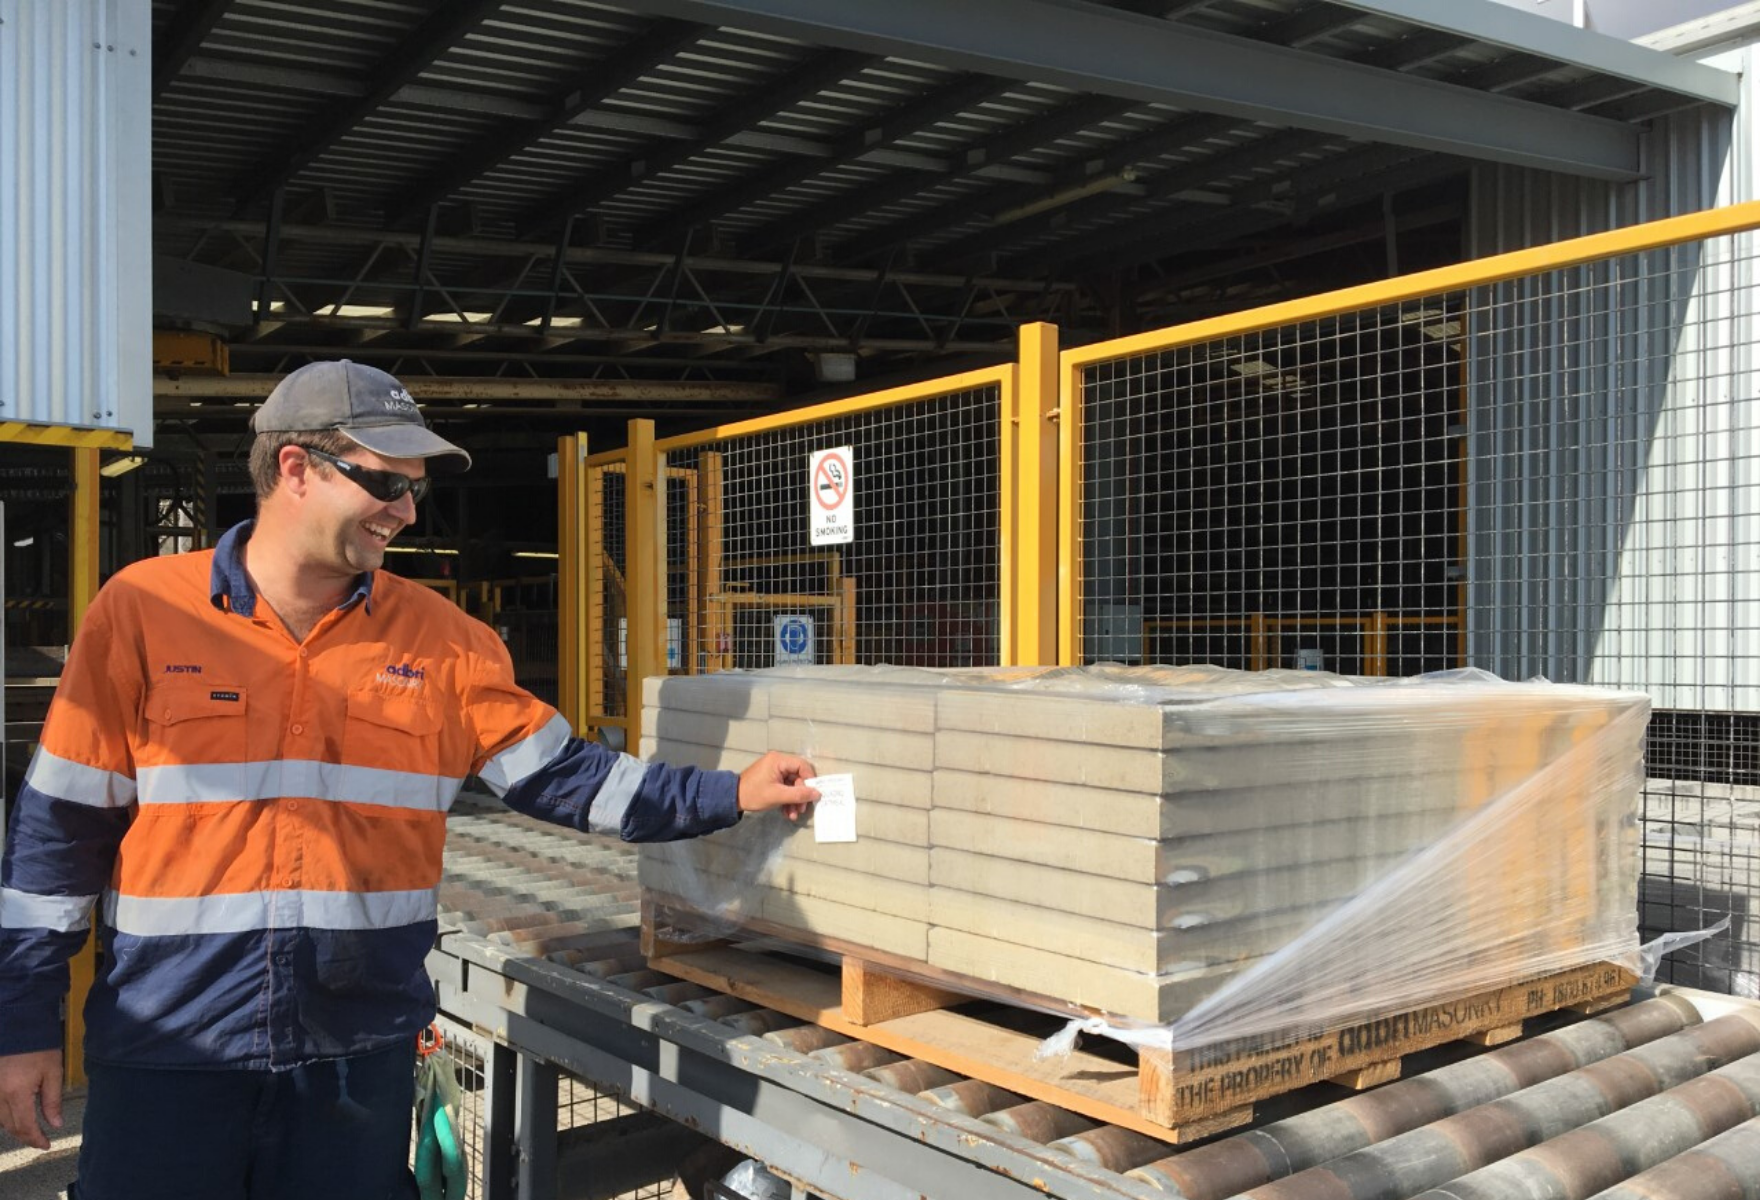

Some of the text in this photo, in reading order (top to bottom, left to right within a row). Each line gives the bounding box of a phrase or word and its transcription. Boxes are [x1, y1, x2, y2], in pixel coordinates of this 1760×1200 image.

[826, 514, 836, 524] NO
[815, 525, 848, 537] SMOKING
[165, 665, 202, 674] JUSTIN
[386, 663, 425, 681] adbri
[1175, 1077, 1214, 1108] THE
[1309, 1044, 1333, 1076] OF
[1412, 988, 1503, 1036] MASONRY
